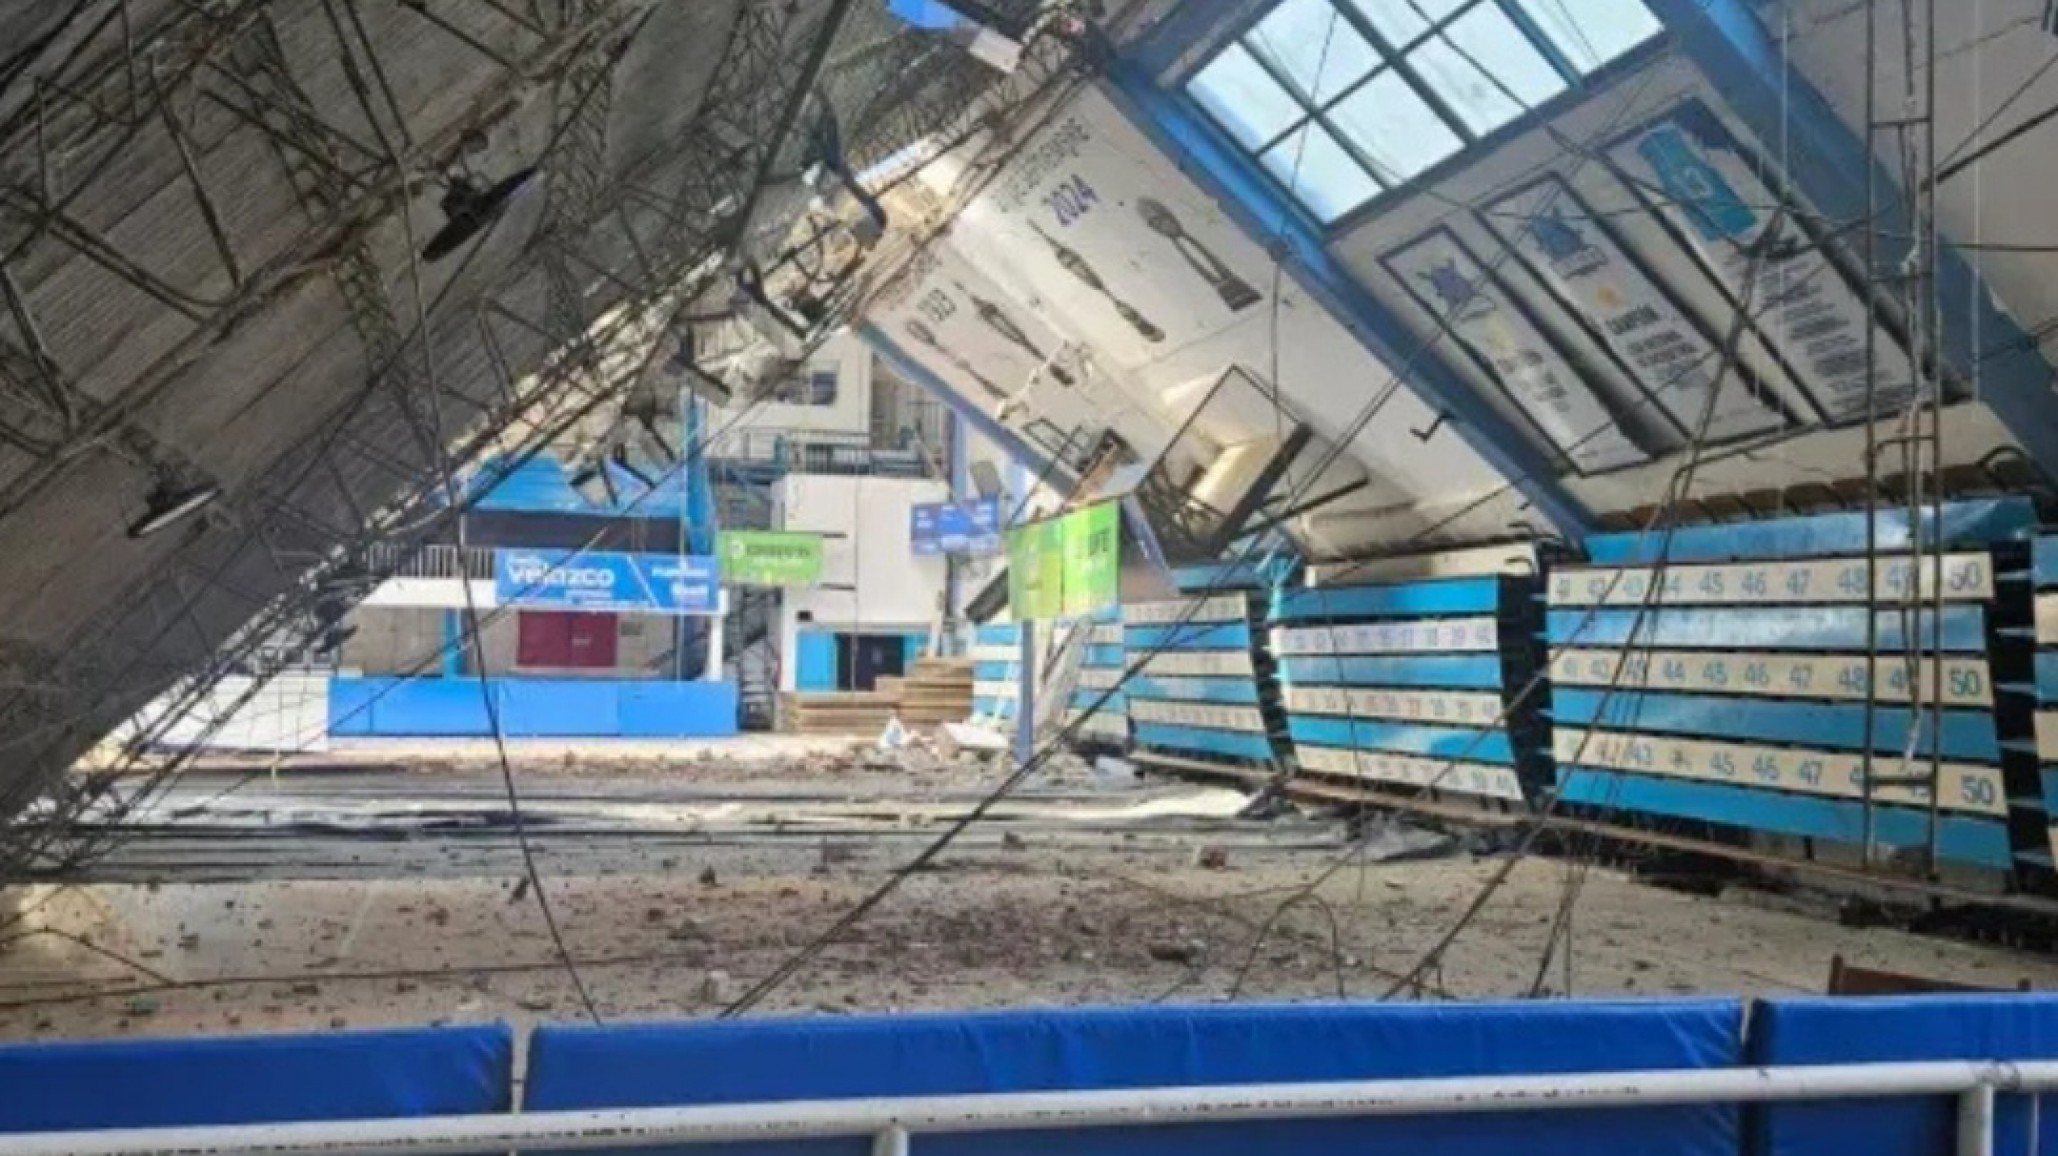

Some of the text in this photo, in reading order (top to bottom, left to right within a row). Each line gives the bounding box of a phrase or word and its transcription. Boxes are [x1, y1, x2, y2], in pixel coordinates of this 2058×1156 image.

[1042, 174, 1100, 227] 2024
[1698, 571, 1725, 595] 45
[1741, 571, 1768, 595] 46
[1787, 568, 1811, 595] 47
[1837, 567, 1868, 595] 48
[1950, 561, 1982, 591] 50
[1662, 657, 1686, 683] 44
[1702, 659, 1728, 685] 45
[1744, 661, 1769, 687] 46
[1789, 664, 1814, 690] 47
[1838, 666, 1868, 693] 48
[1949, 669, 1982, 698] 50
[1709, 749, 1736, 777] 45
[1752, 756, 1781, 784] 46
[1798, 758, 1823, 787] 47
[1960, 774, 1996, 806] 50
